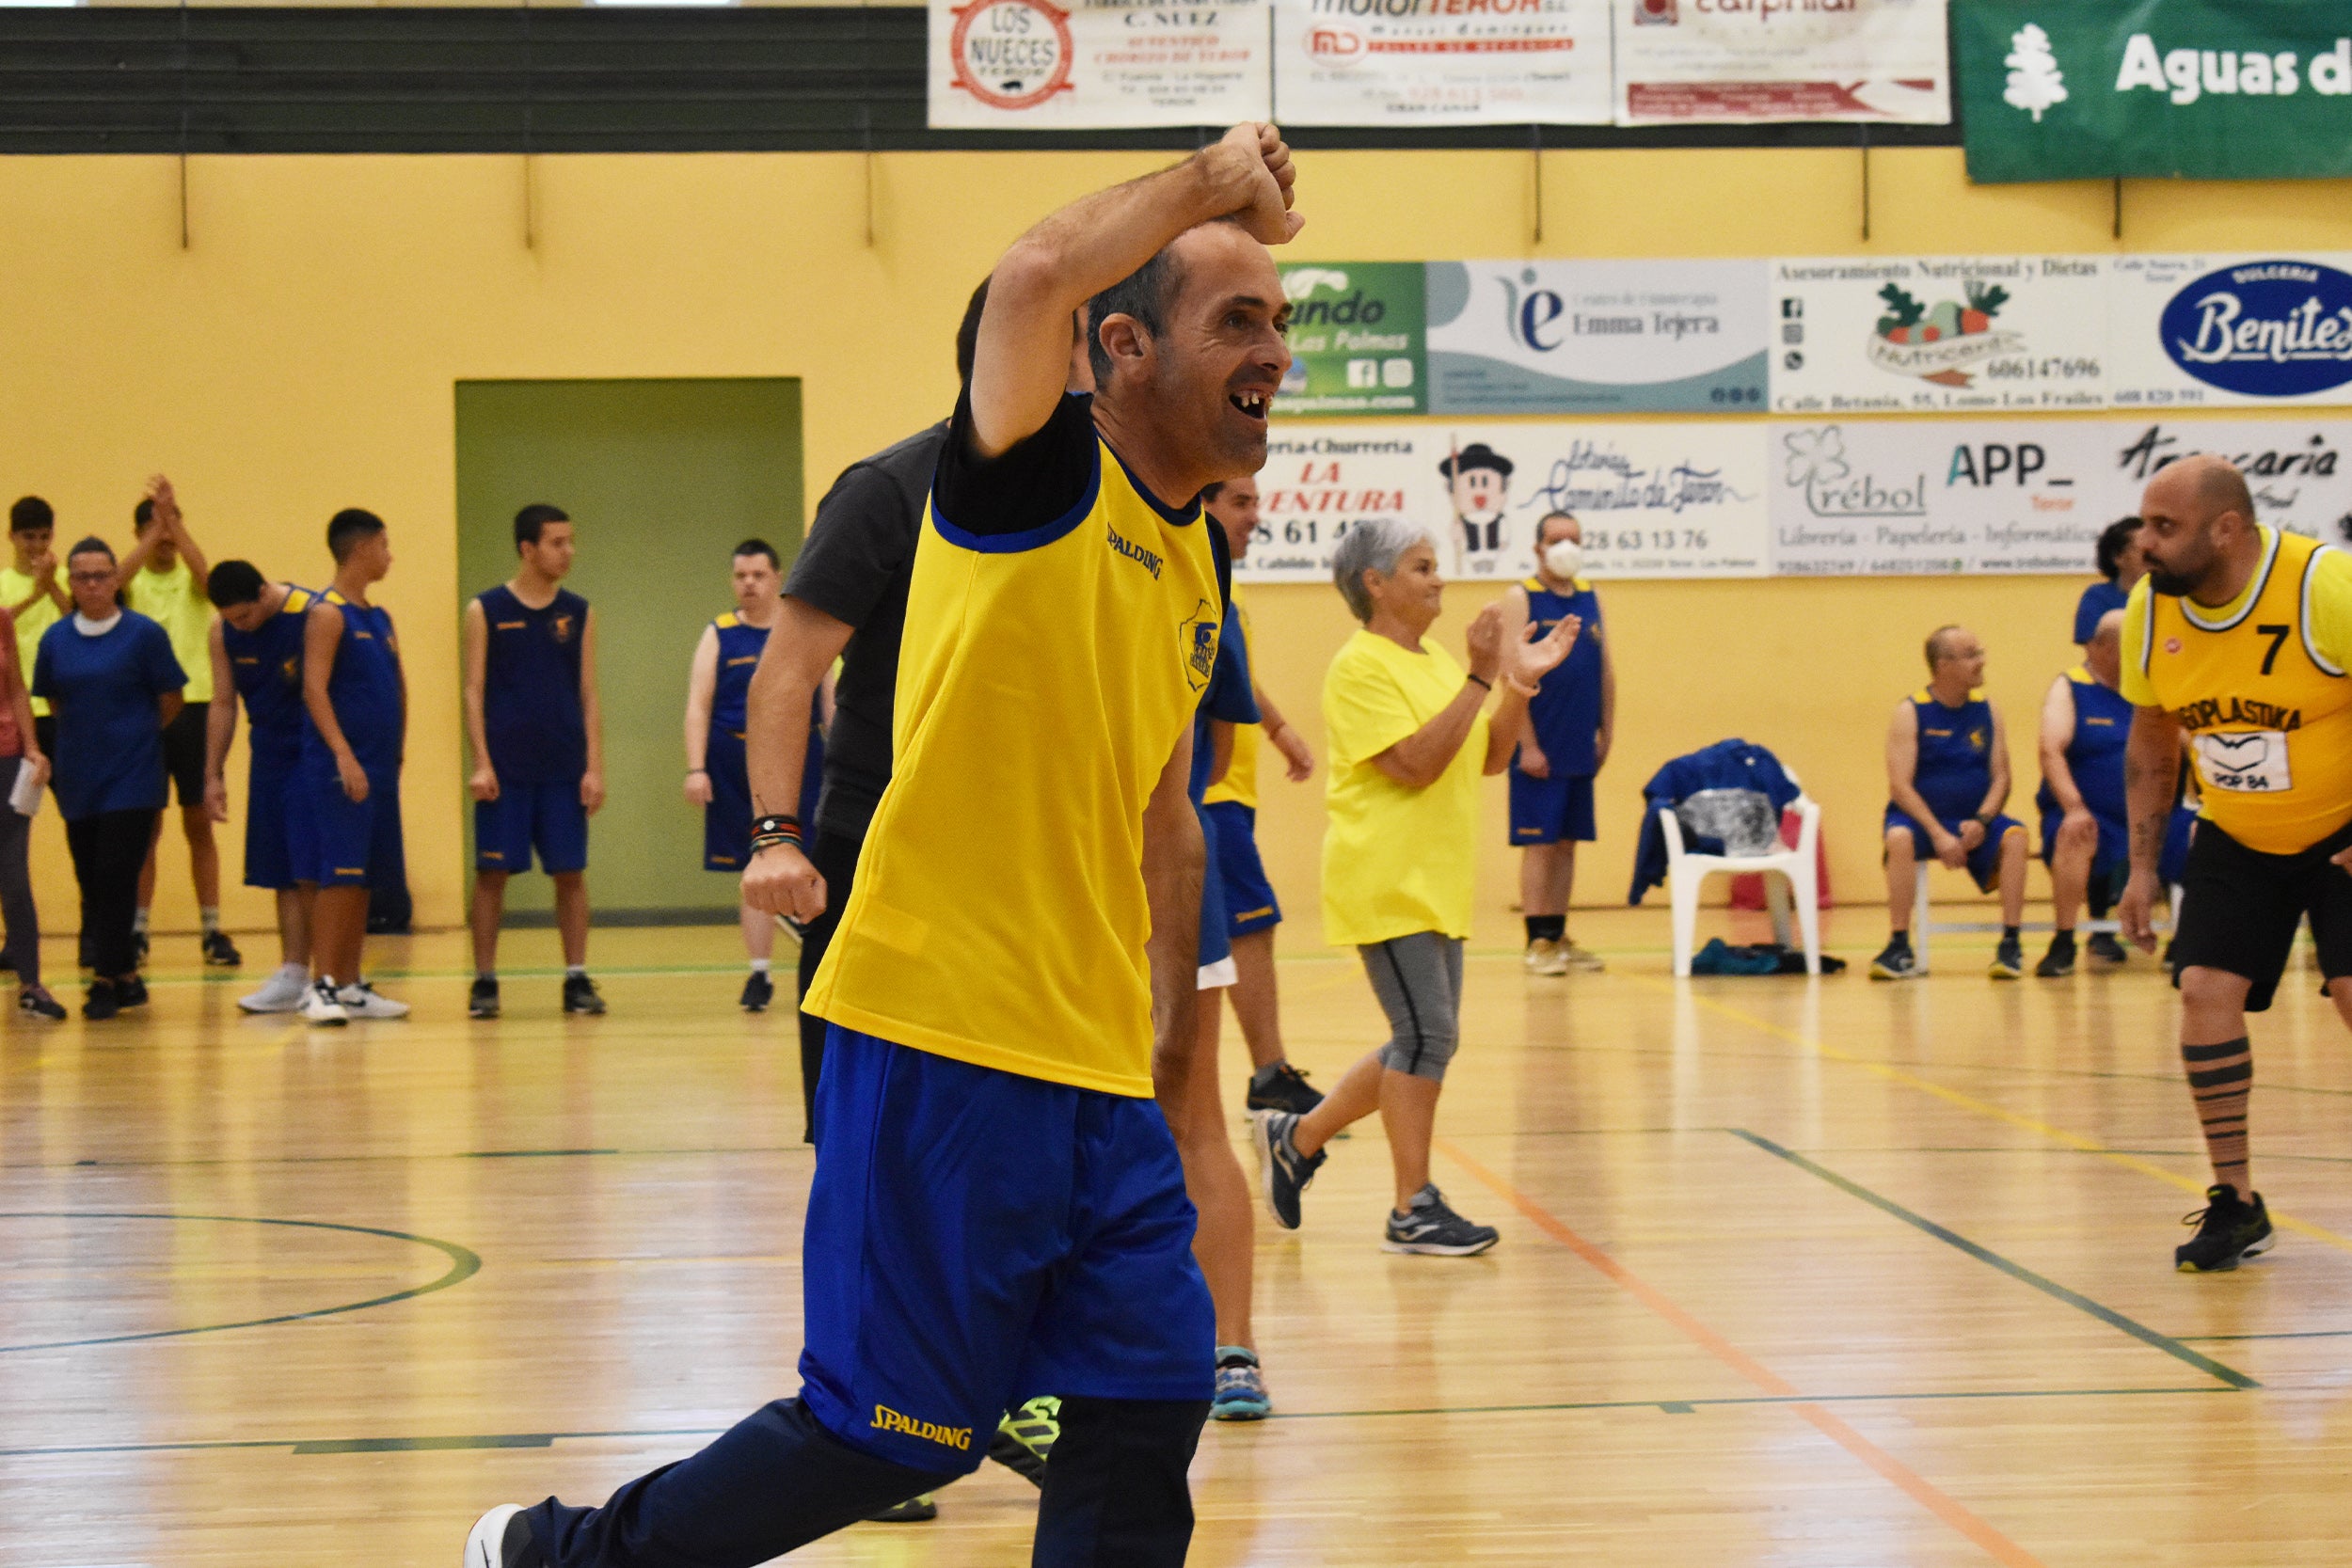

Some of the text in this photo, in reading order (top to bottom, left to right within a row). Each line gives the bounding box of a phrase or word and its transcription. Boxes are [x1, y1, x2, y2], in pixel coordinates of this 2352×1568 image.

[992, 7, 1031, 34] LOS
[2115, 34, 2299, 105] Aguas
[1288, 290, 1386, 325] undo
[2120, 424, 2339, 478] Arcaria
[1285, 519, 1318, 545] 61
[1581, 529, 1709, 550] 28 63 13 76
[2257, 624, 2290, 675] 7
[2178, 696, 2301, 733] GOPLASTIKA
[870, 1404, 974, 1451] SPALDING
